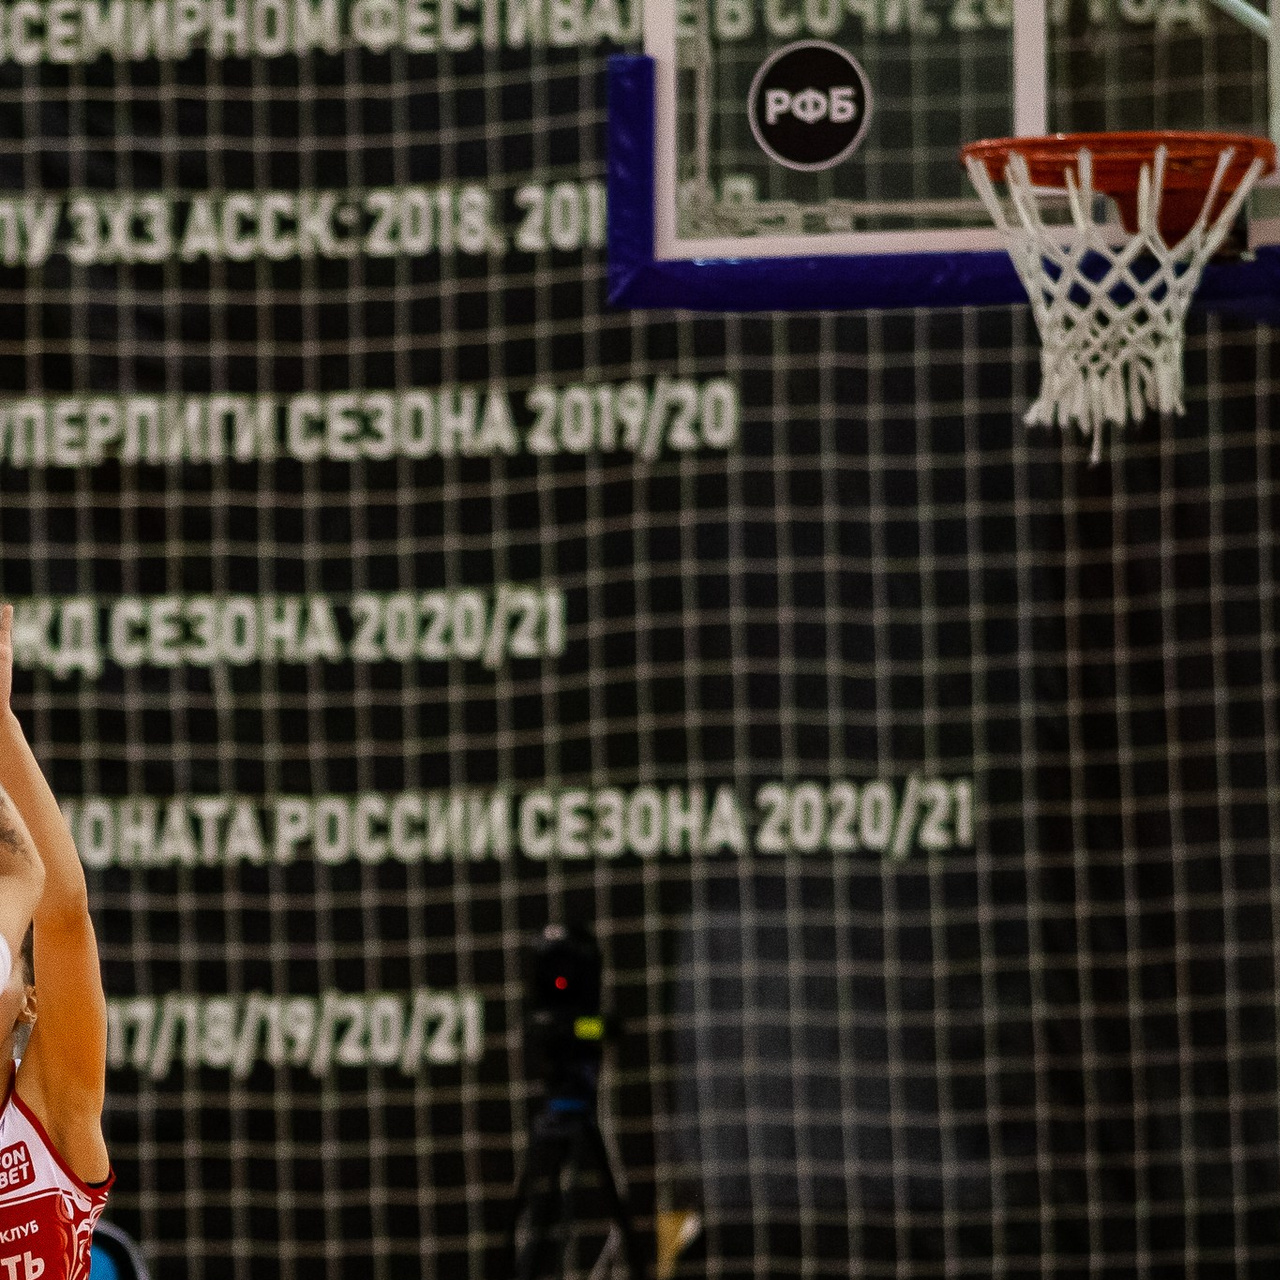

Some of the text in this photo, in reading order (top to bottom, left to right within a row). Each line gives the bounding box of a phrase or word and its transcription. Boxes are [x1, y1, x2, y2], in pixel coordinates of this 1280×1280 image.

[764, 86, 857, 126] РФБ
[515, 180, 608, 251] 201
[287, 391, 518, 462] СЕЗОНА
[525, 374, 739, 461] 2019/20
[110, 595, 342, 668] СЕЗОНА
[350, 584, 567, 669] 2020/21
[272, 792, 515, 868] РОССИИ
[519, 782, 749, 861] СЕЗОНА
[754, 772, 975, 862] 2020/21
[0, 1219, 40, 1244] КЛУБ
